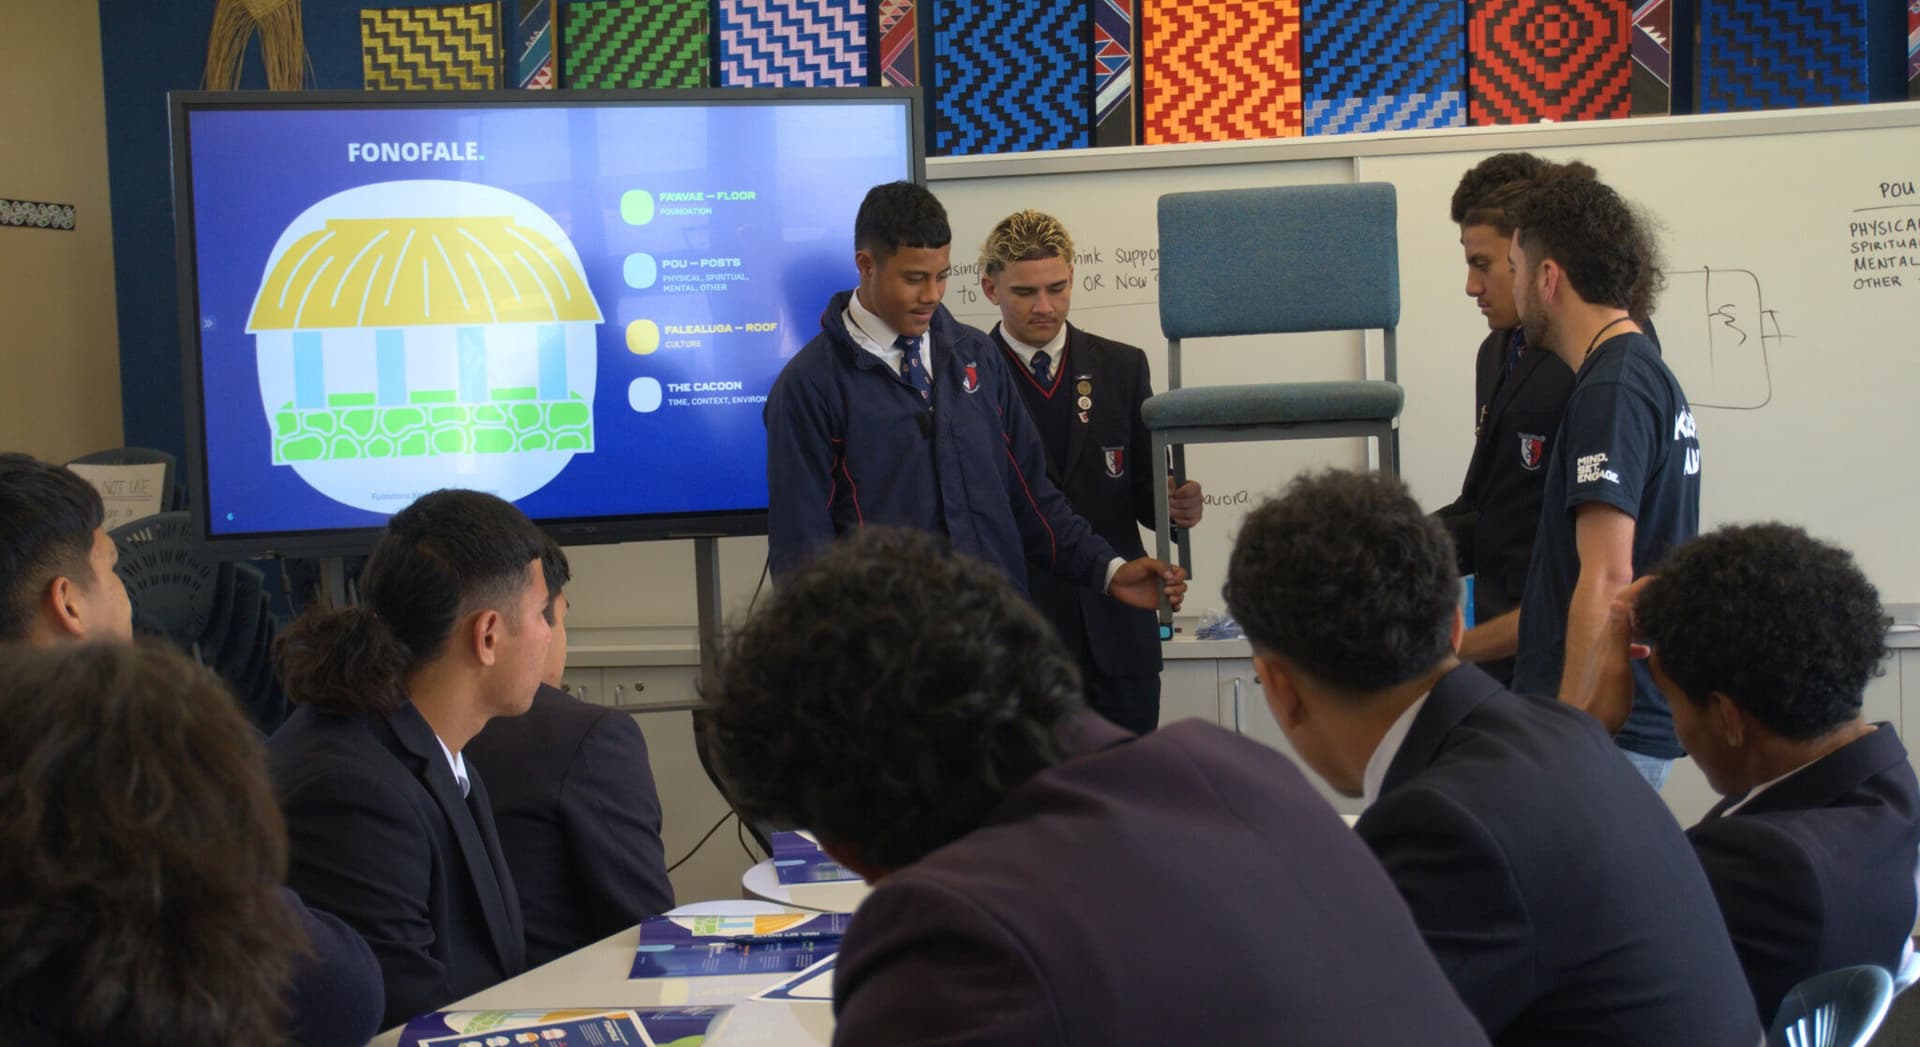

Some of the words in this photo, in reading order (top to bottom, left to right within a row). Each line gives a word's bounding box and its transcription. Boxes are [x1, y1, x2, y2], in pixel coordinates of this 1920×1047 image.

[348, 141, 485, 162] FONOFALE.
[717, 191, 756, 200] FLOOR
[1879, 181, 1915, 198] POU
[660, 207, 712, 216] FOUNDATION
[1849, 218, 1920, 238] PHYSICA
[1850, 238, 1920, 254] SPIRITUA
[662, 260, 688, 268] POU
[701, 258, 741, 267] POSTS
[948, 262, 980, 286] sing
[1073, 246, 1104, 265] hink
[1115, 247, 1159, 268] Suppo
[1854, 256, 1920, 273] MENTAL
[700, 283, 727, 291] OTHER
[1083, 273, 1104, 291] OR
[1853, 276, 1902, 290] OTHER
[665, 324, 733, 334] FALEALUGA
[745, 323, 778, 332] ROOF
[665, 340, 701, 348] CULTURE
[667, 383, 691, 392] THE
[693, 381, 742, 391] CACOON
[691, 397, 730, 405] CONTEXT,
[732, 395, 767, 403] ENVIRON
[1577, 453, 1608, 466] MIND.
[1202, 490, 1247, 505] auora
